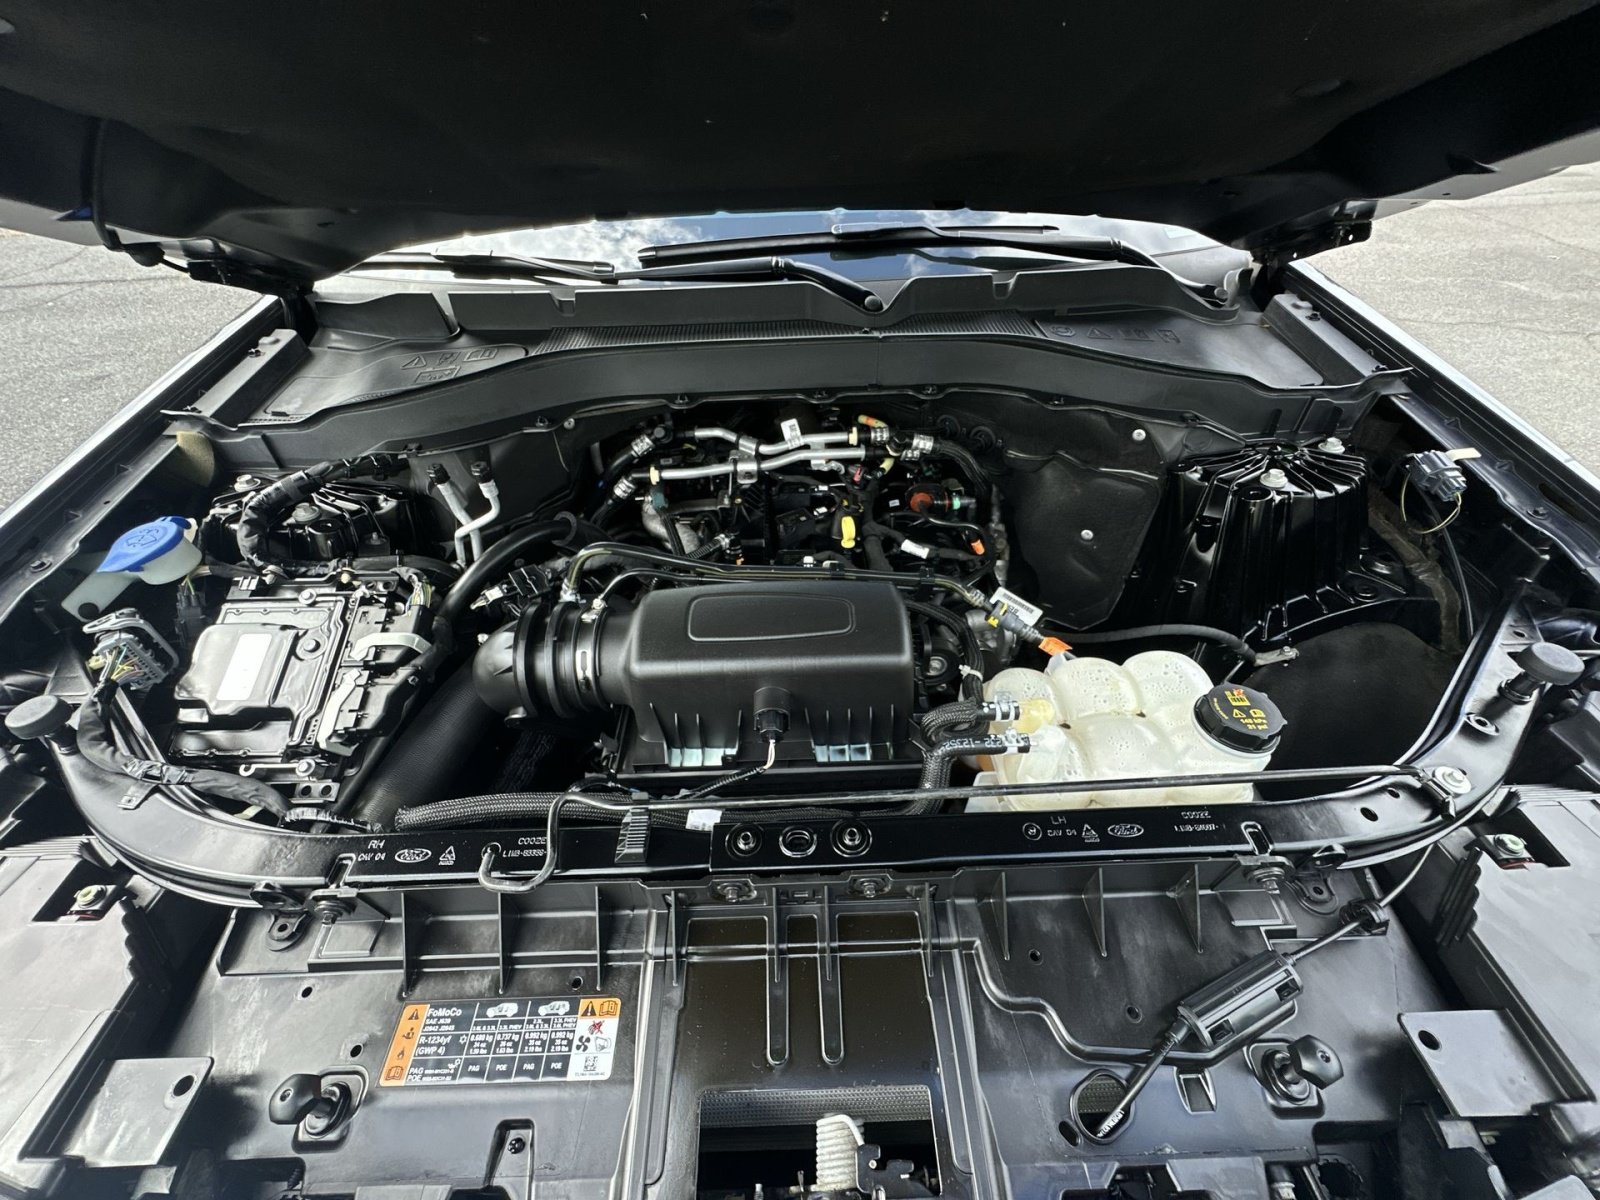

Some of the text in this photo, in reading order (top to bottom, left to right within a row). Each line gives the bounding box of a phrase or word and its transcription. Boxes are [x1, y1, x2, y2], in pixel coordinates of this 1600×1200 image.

[1050, 816, 1067, 825] LH
[367, 839, 386, 849] RH
[427, 1007, 462, 1017] FoMoCo
[418, 1035, 452, 1045] R-1234yf
[486, 1034, 494, 1043] kg
[511, 1033, 520, 1042] kg
[540, 1032, 548, 1041] kg
[566, 1031, 574, 1040] kg
[415, 1046, 446, 1056] (GWP 4)
[467, 1064, 480, 1072] PAG
[522, 1063, 535, 1071] PAG
[550, 1062, 562, 1070] POE
[409, 1067, 424, 1075] PAG
[406, 1074, 422, 1082] POE
